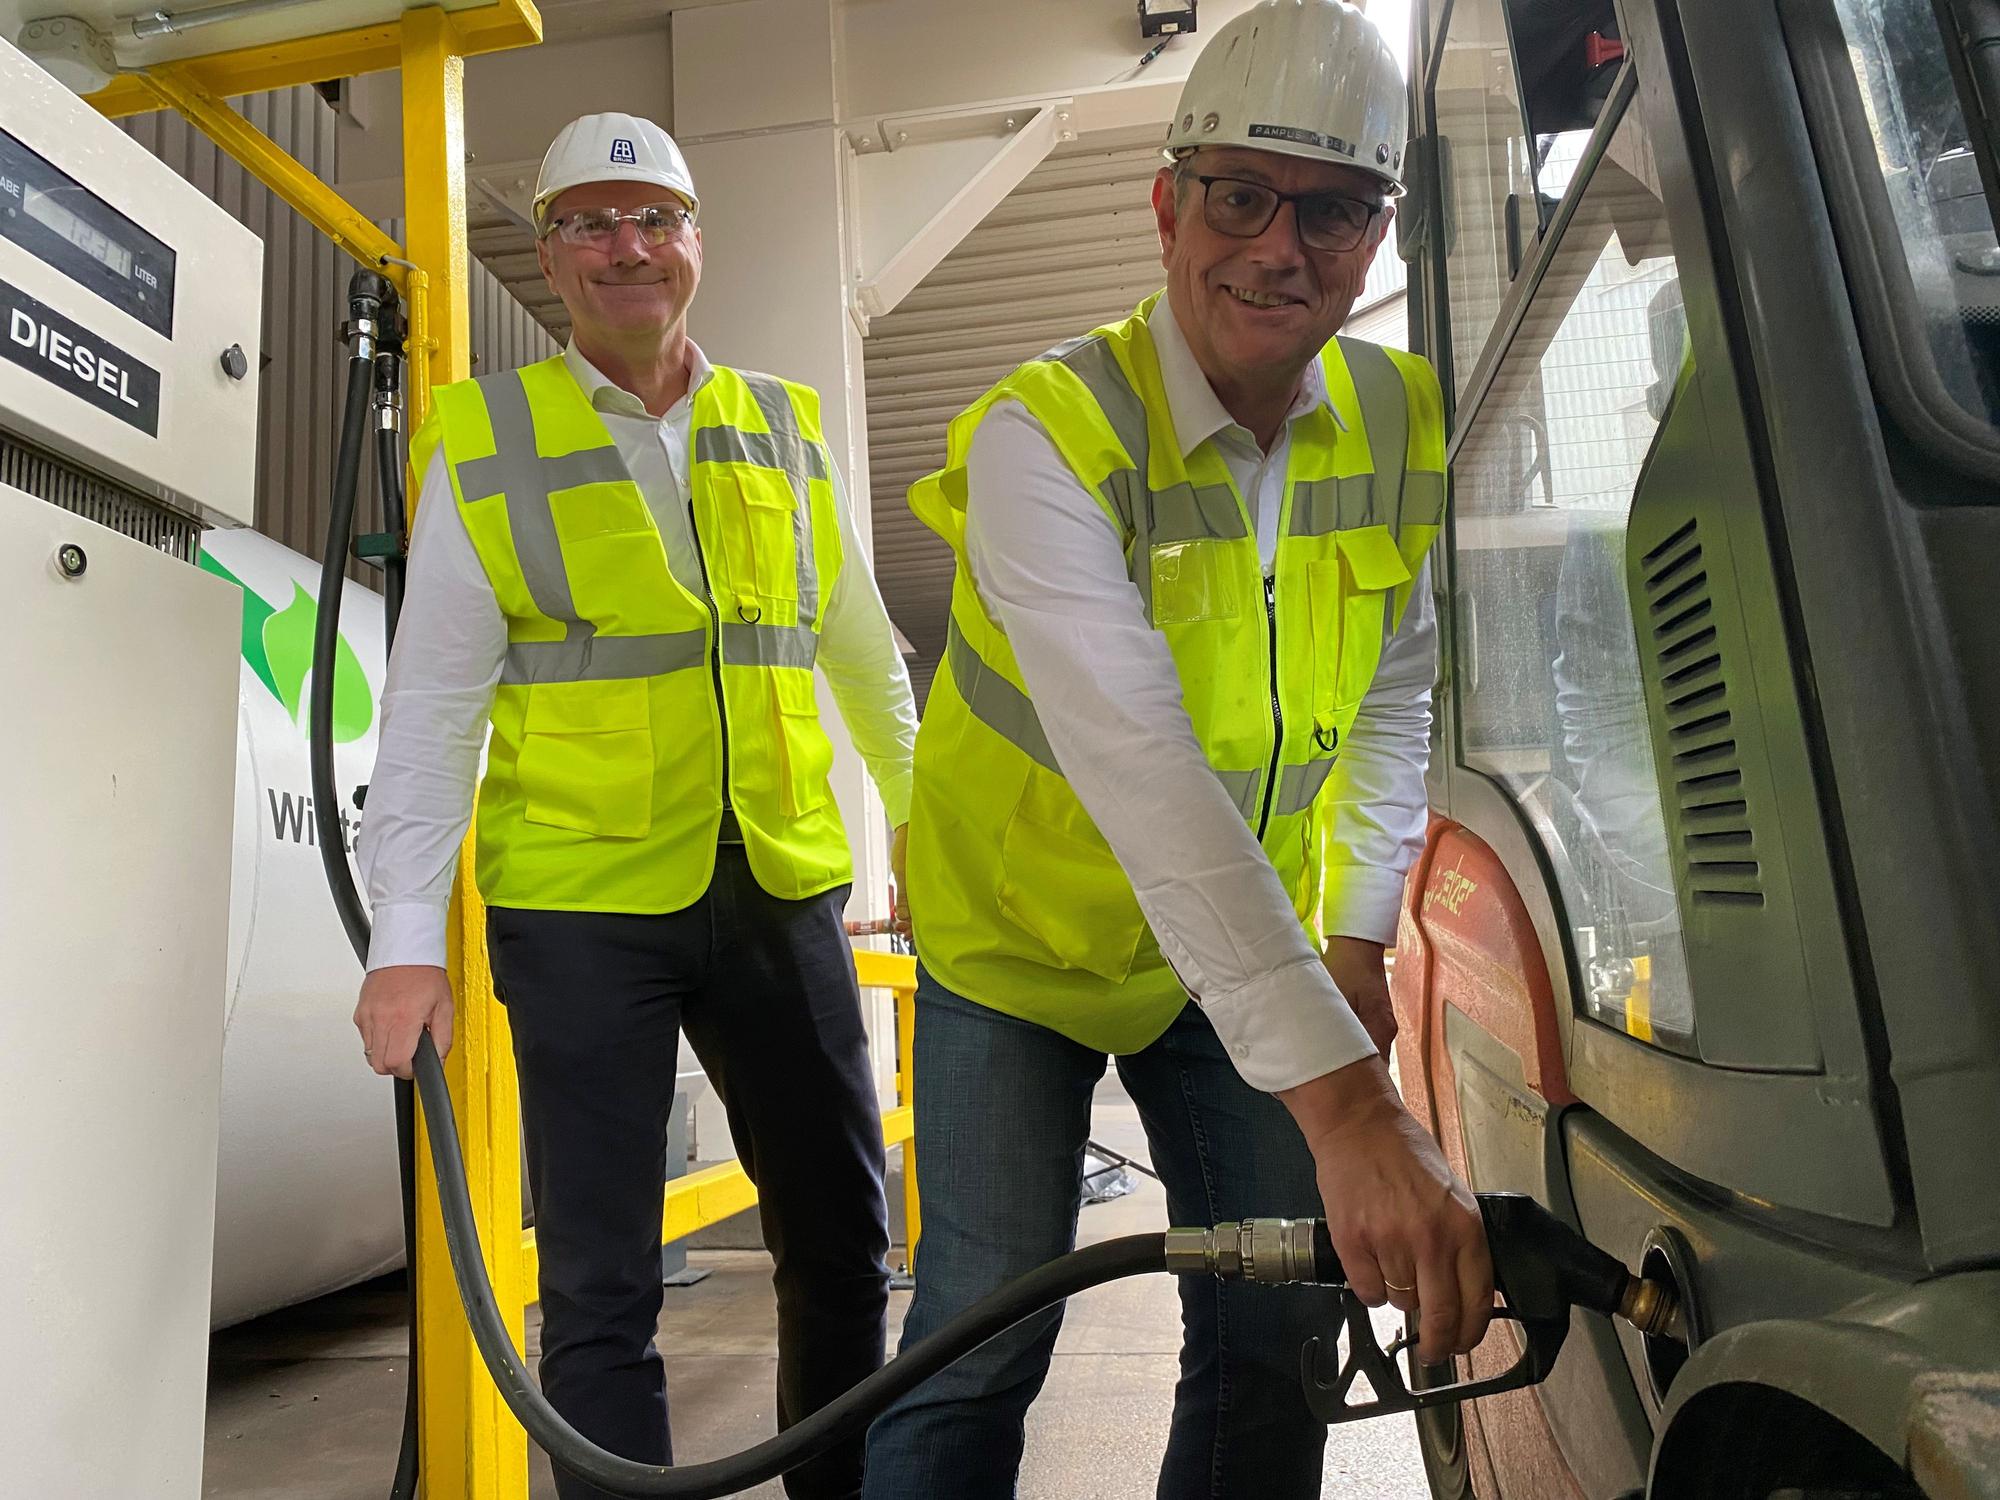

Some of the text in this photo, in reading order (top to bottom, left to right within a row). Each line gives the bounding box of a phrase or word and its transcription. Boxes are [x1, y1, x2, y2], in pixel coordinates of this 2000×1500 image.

[613, 140, 633, 158] EB
[135, 264, 157, 289] LITER
[9, 307, 139, 408] DIESEL
